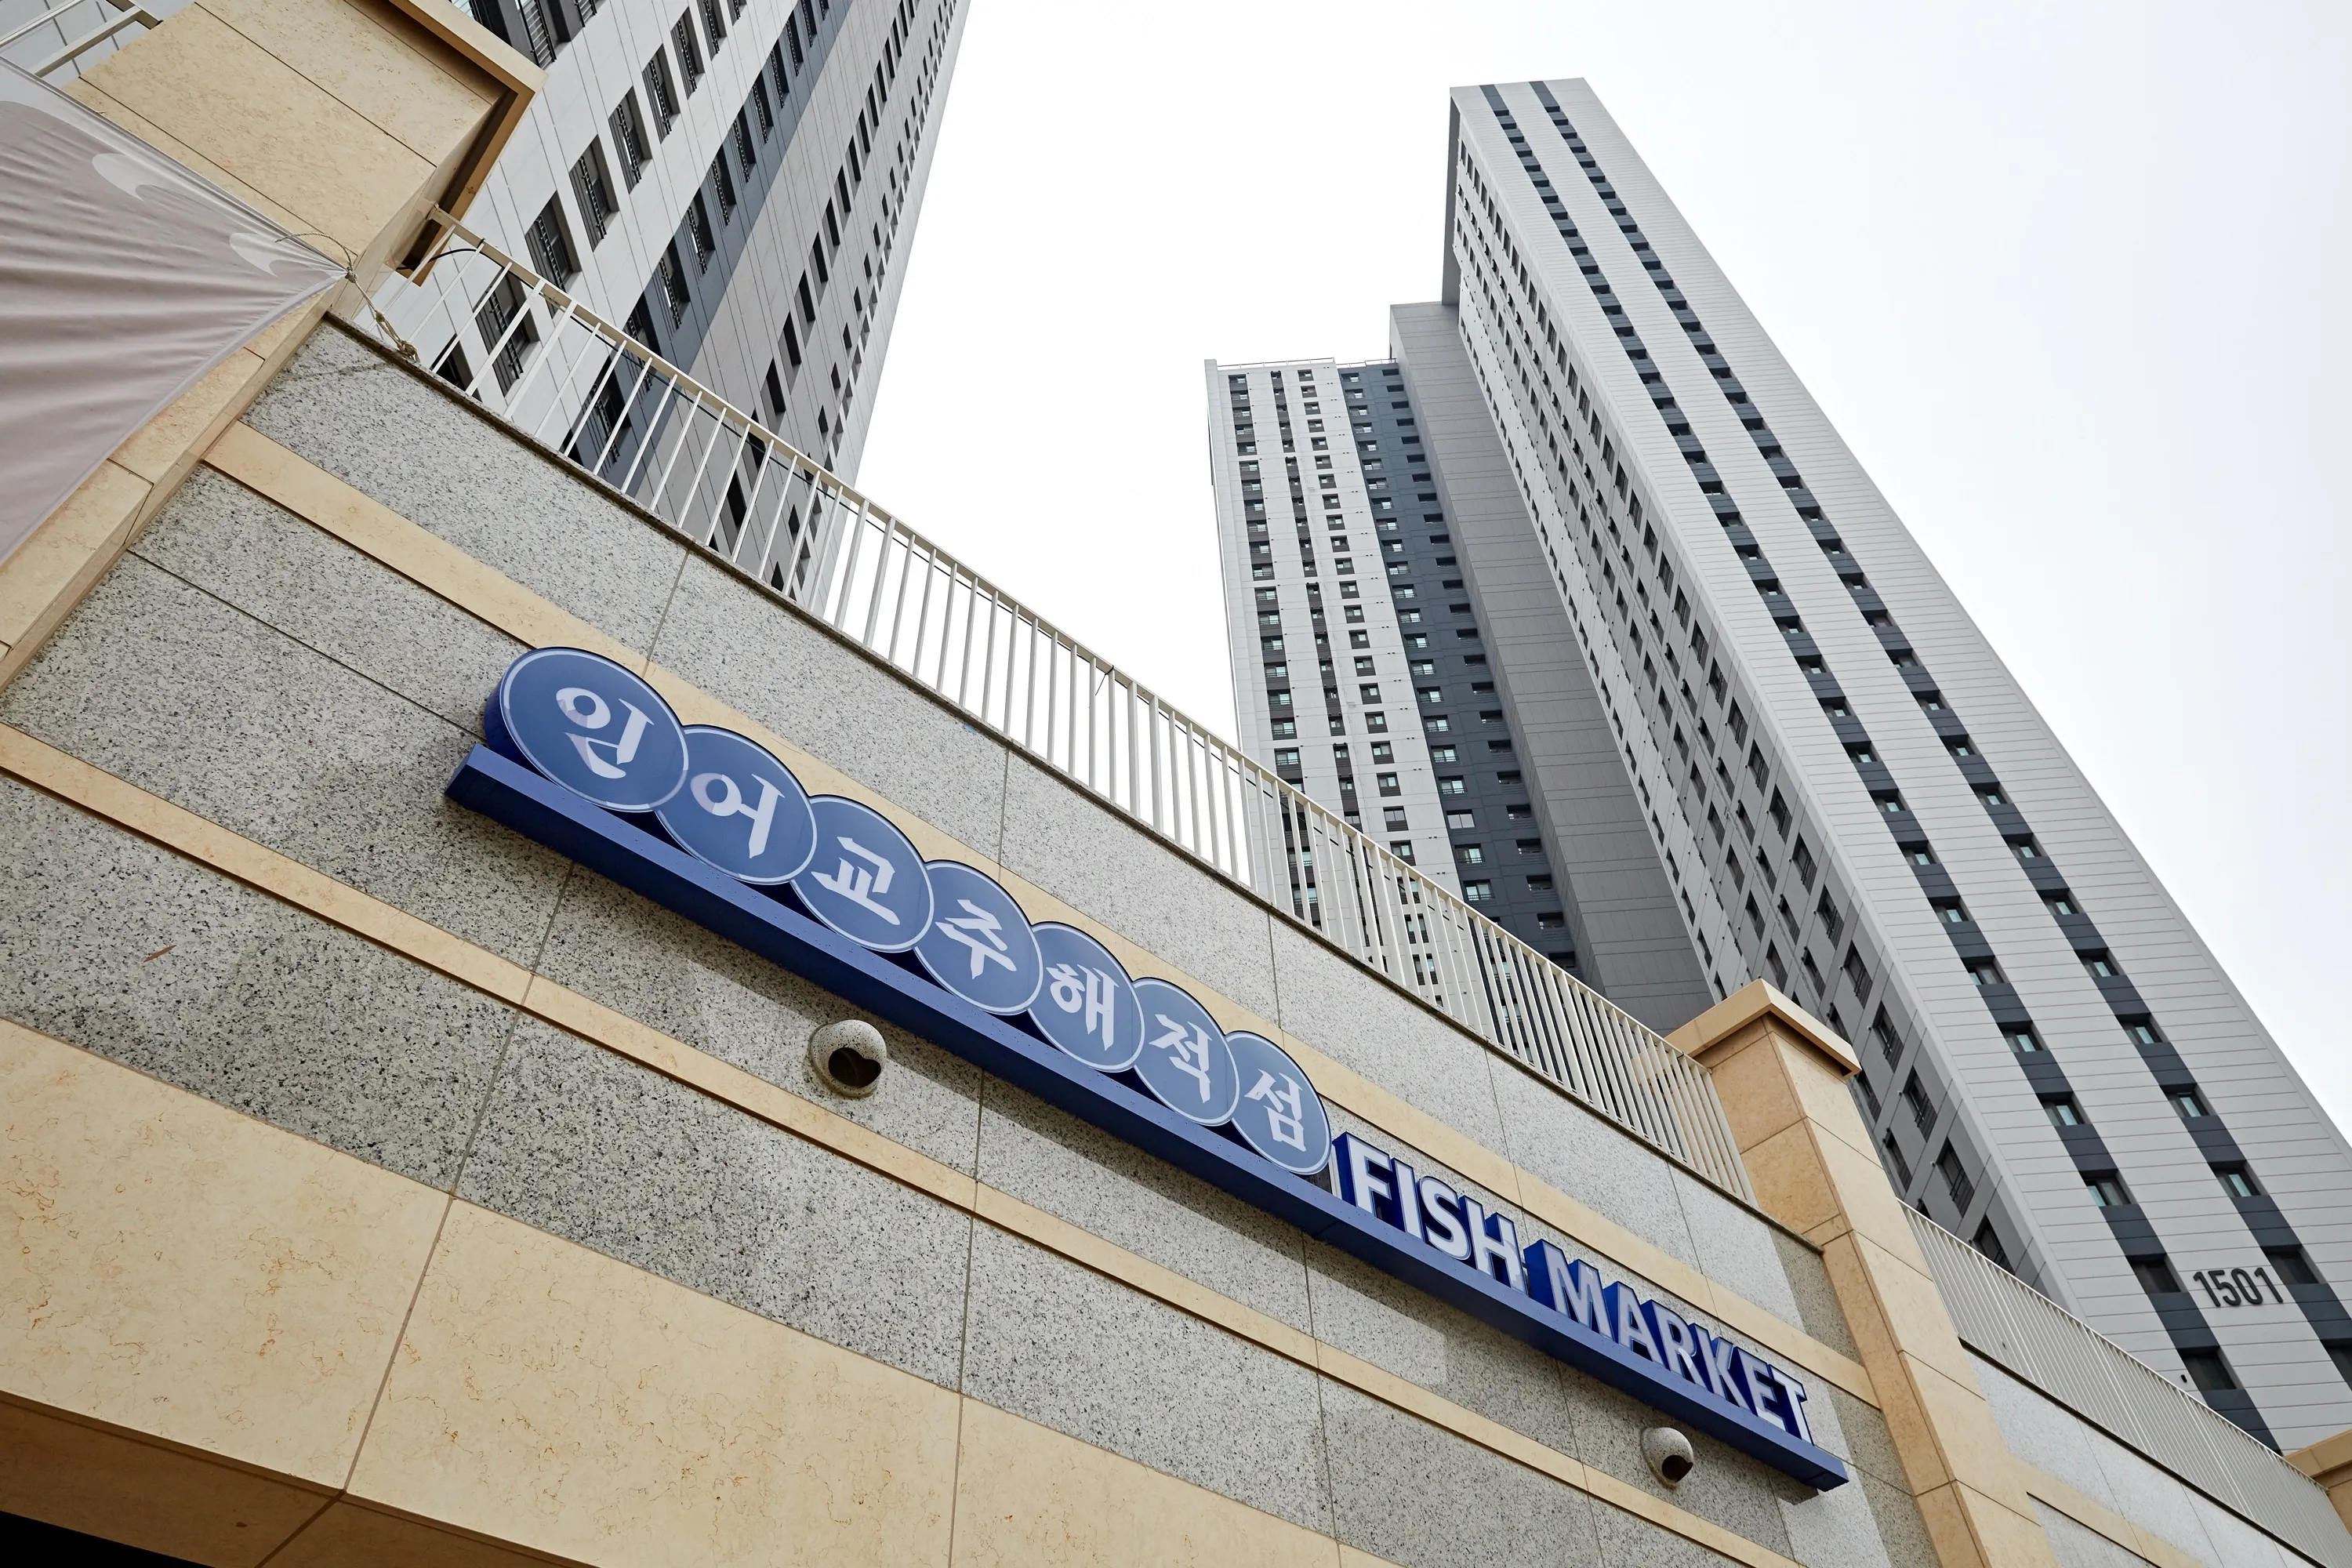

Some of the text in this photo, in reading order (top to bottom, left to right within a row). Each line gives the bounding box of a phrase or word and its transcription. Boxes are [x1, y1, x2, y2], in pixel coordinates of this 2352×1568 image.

[555, 687, 1307, 1152] 인어교주해적섬
[1340, 1132, 1813, 1446] FISH MARKET
[2193, 1267, 2283, 1307] 1501
